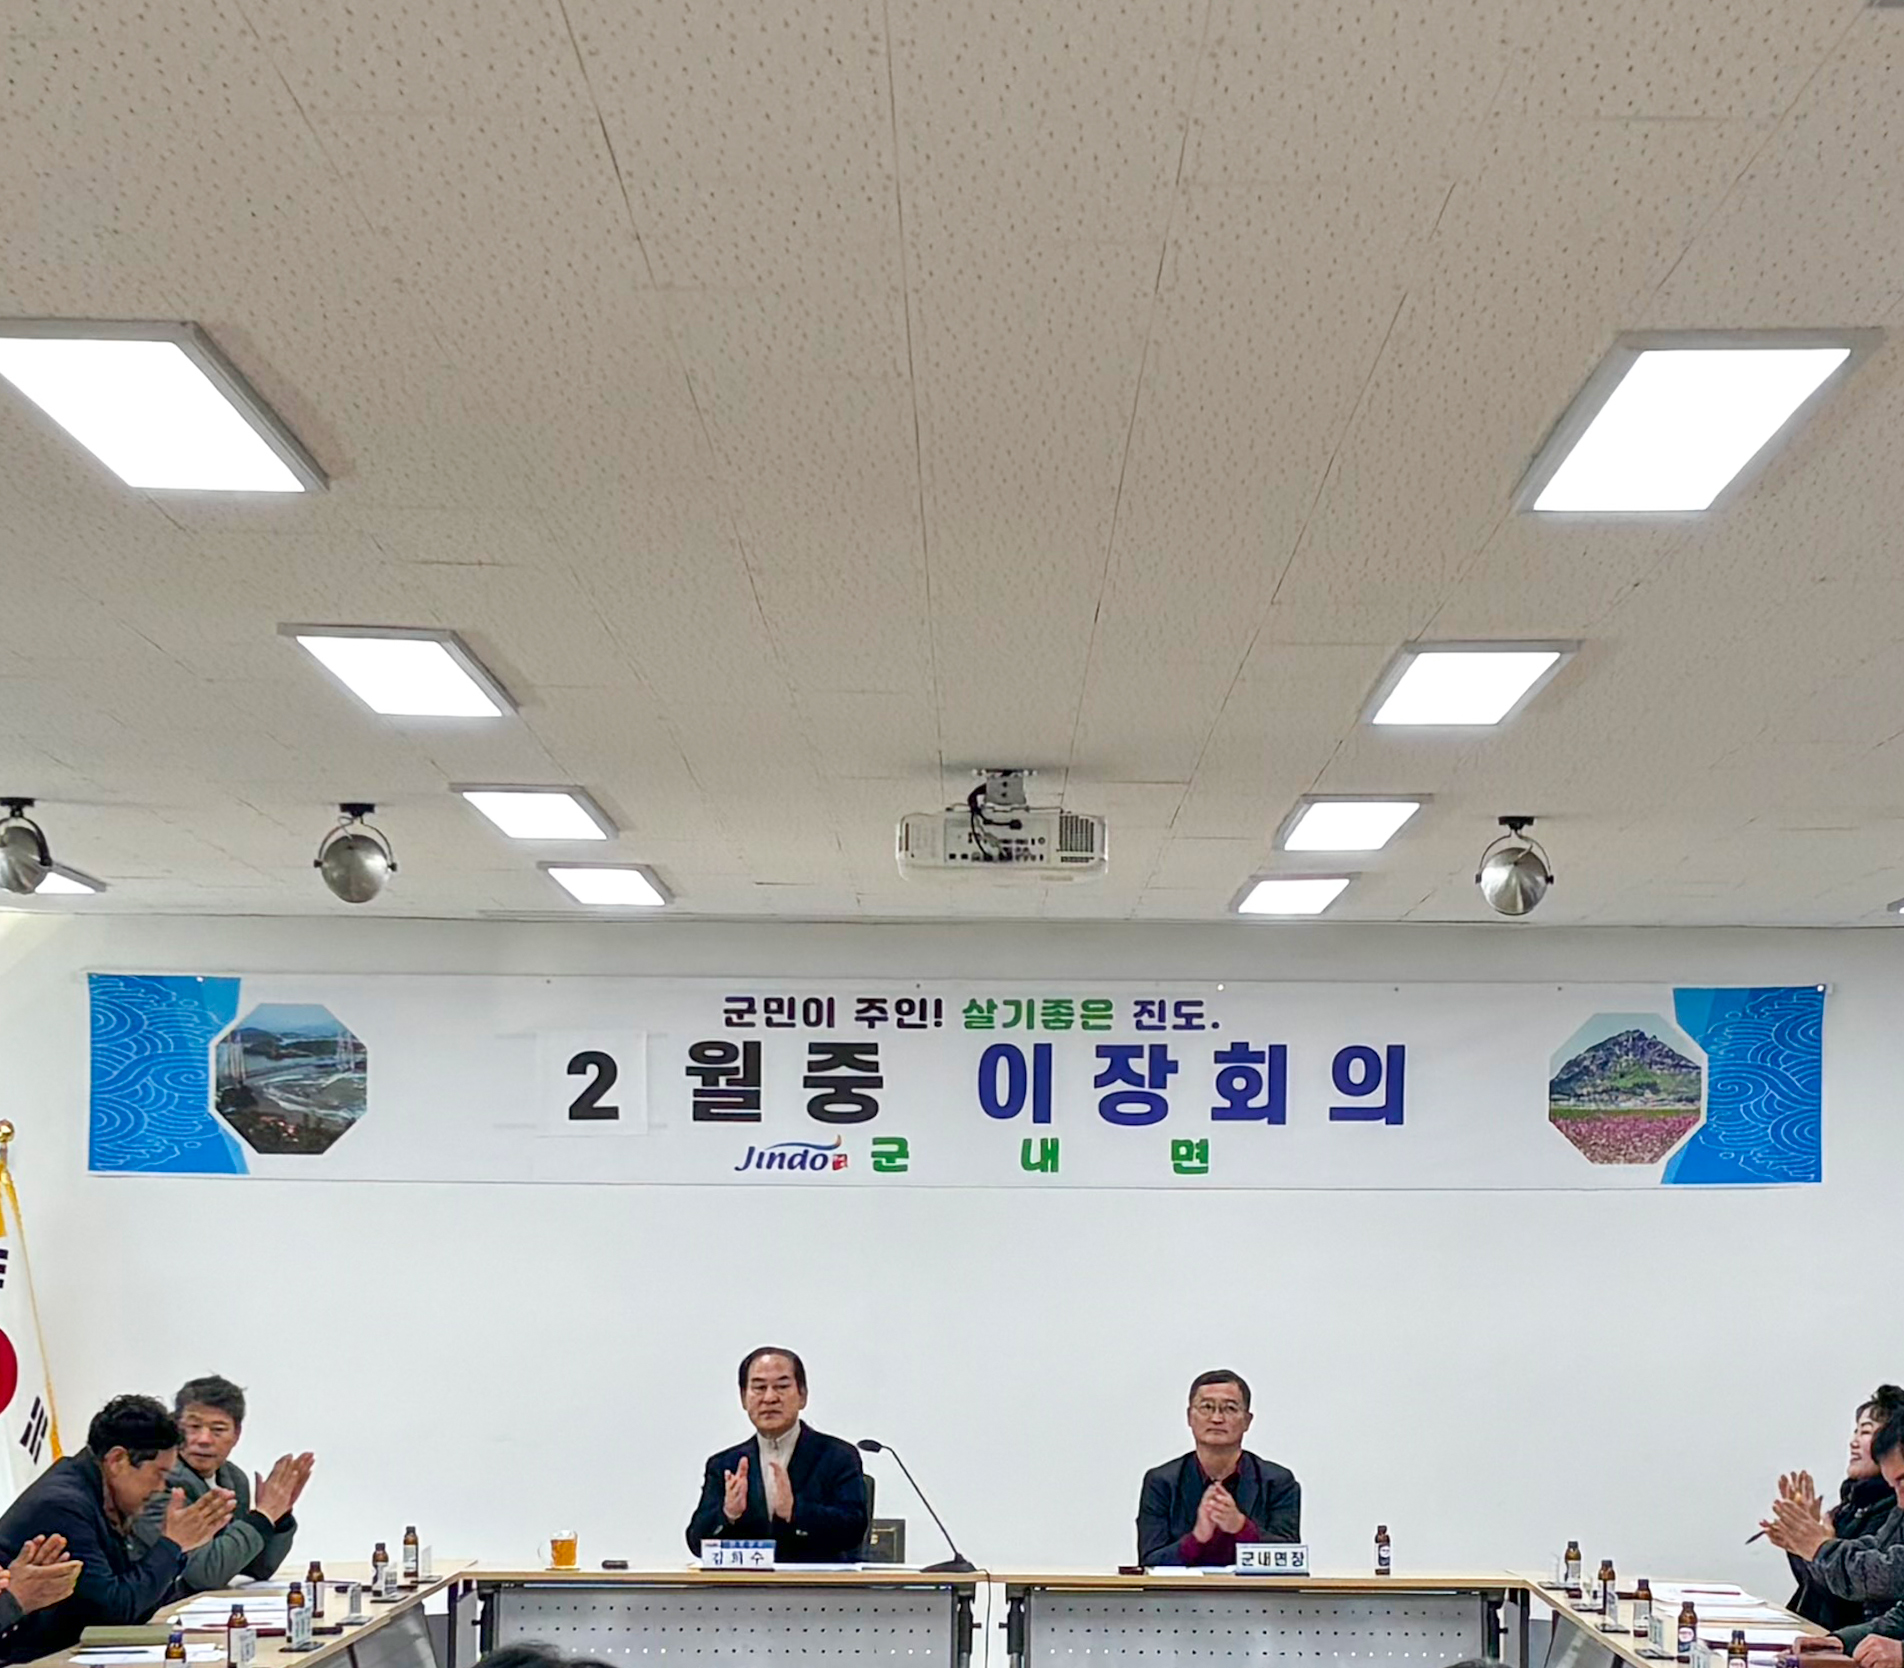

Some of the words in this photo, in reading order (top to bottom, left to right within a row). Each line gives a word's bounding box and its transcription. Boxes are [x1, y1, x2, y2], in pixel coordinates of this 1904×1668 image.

[723, 996, 836, 1029] 군민이
[853, 997, 944, 1030] 주인!
[962, 997, 1114, 1031] 살기좋은
[1133, 999, 1221, 1031] 진도.
[566, 1050, 620, 1121] 2
[734, 1145, 830, 1172] Jindo
[1241, 1551, 1304, 1567] 군내면장
